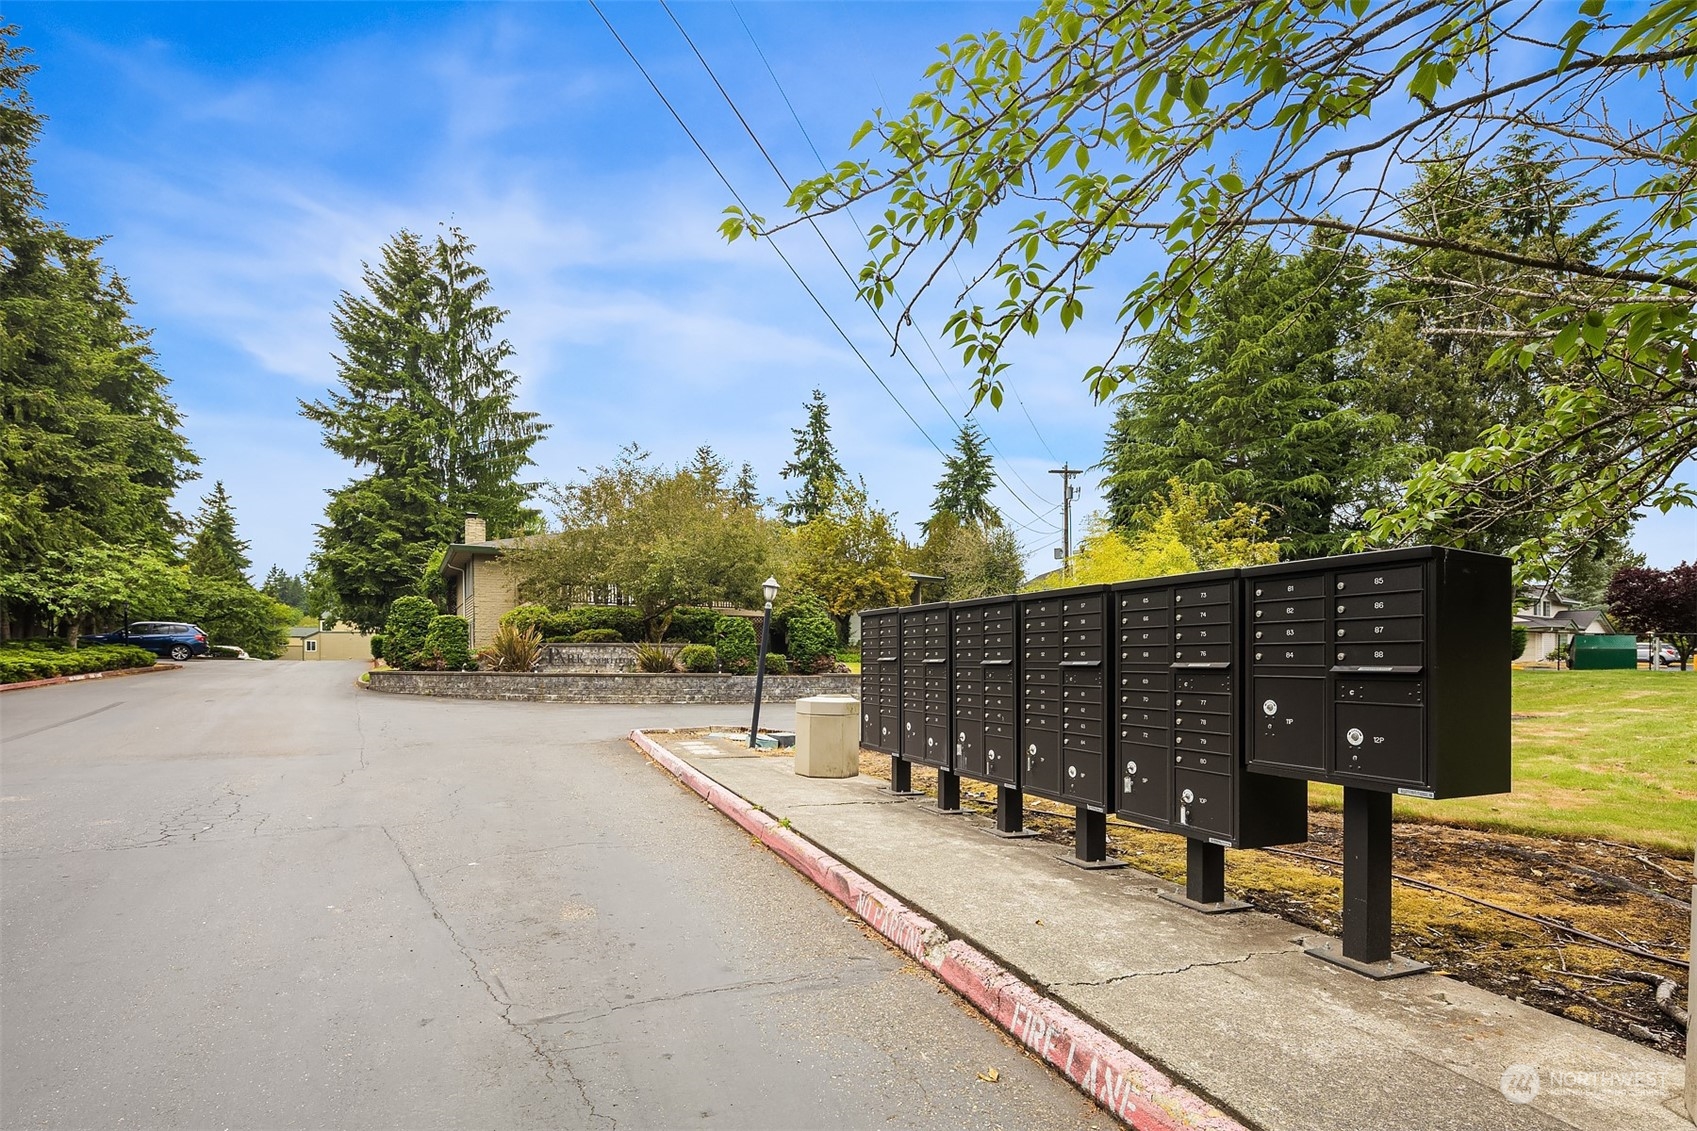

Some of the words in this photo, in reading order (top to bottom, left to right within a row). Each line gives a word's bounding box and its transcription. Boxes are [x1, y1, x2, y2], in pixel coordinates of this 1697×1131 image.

[1373, 577, 1384, 585] 85
[1373, 601, 1384, 610] 86
[1286, 607, 1295, 615] 82
[1286, 629, 1295, 637] 83
[1374, 626, 1384, 634] 87
[548, 647, 585, 665] PARK
[1285, 651, 1294, 659] 84
[1373, 650, 1384, 659] 88
[1373, 736, 1385, 744] 12P
[855, 891, 873, 920] NO
[1009, 1001, 1060, 1062] FIRE
[1065, 1040, 1140, 1125] LANE
